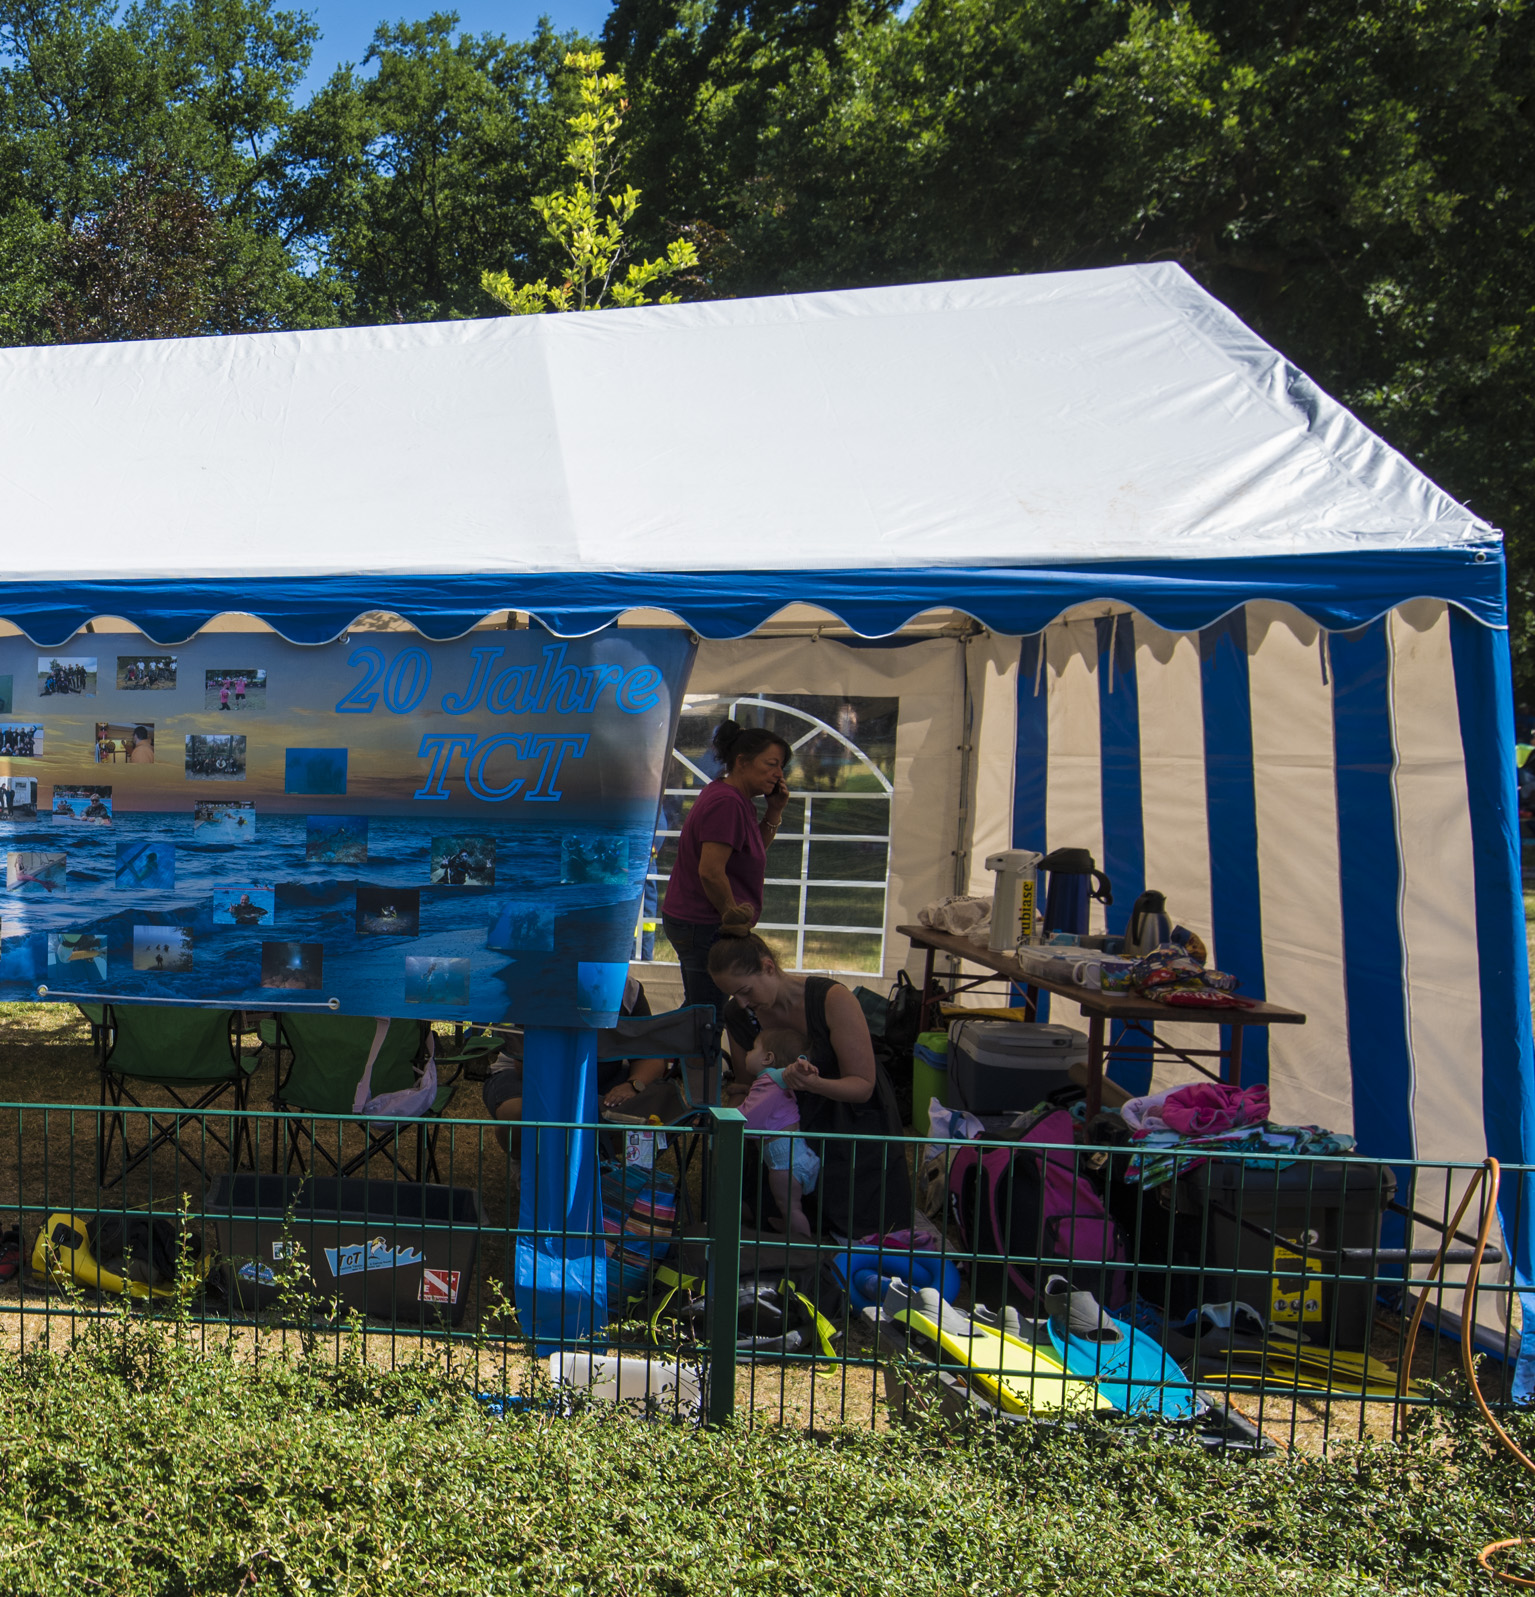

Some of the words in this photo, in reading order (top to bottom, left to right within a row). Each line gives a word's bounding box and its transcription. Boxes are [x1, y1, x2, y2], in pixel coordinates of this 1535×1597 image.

[335, 646, 432, 714] 20
[441, 642, 663, 715] Jahre
[413, 732, 591, 802] TCT
